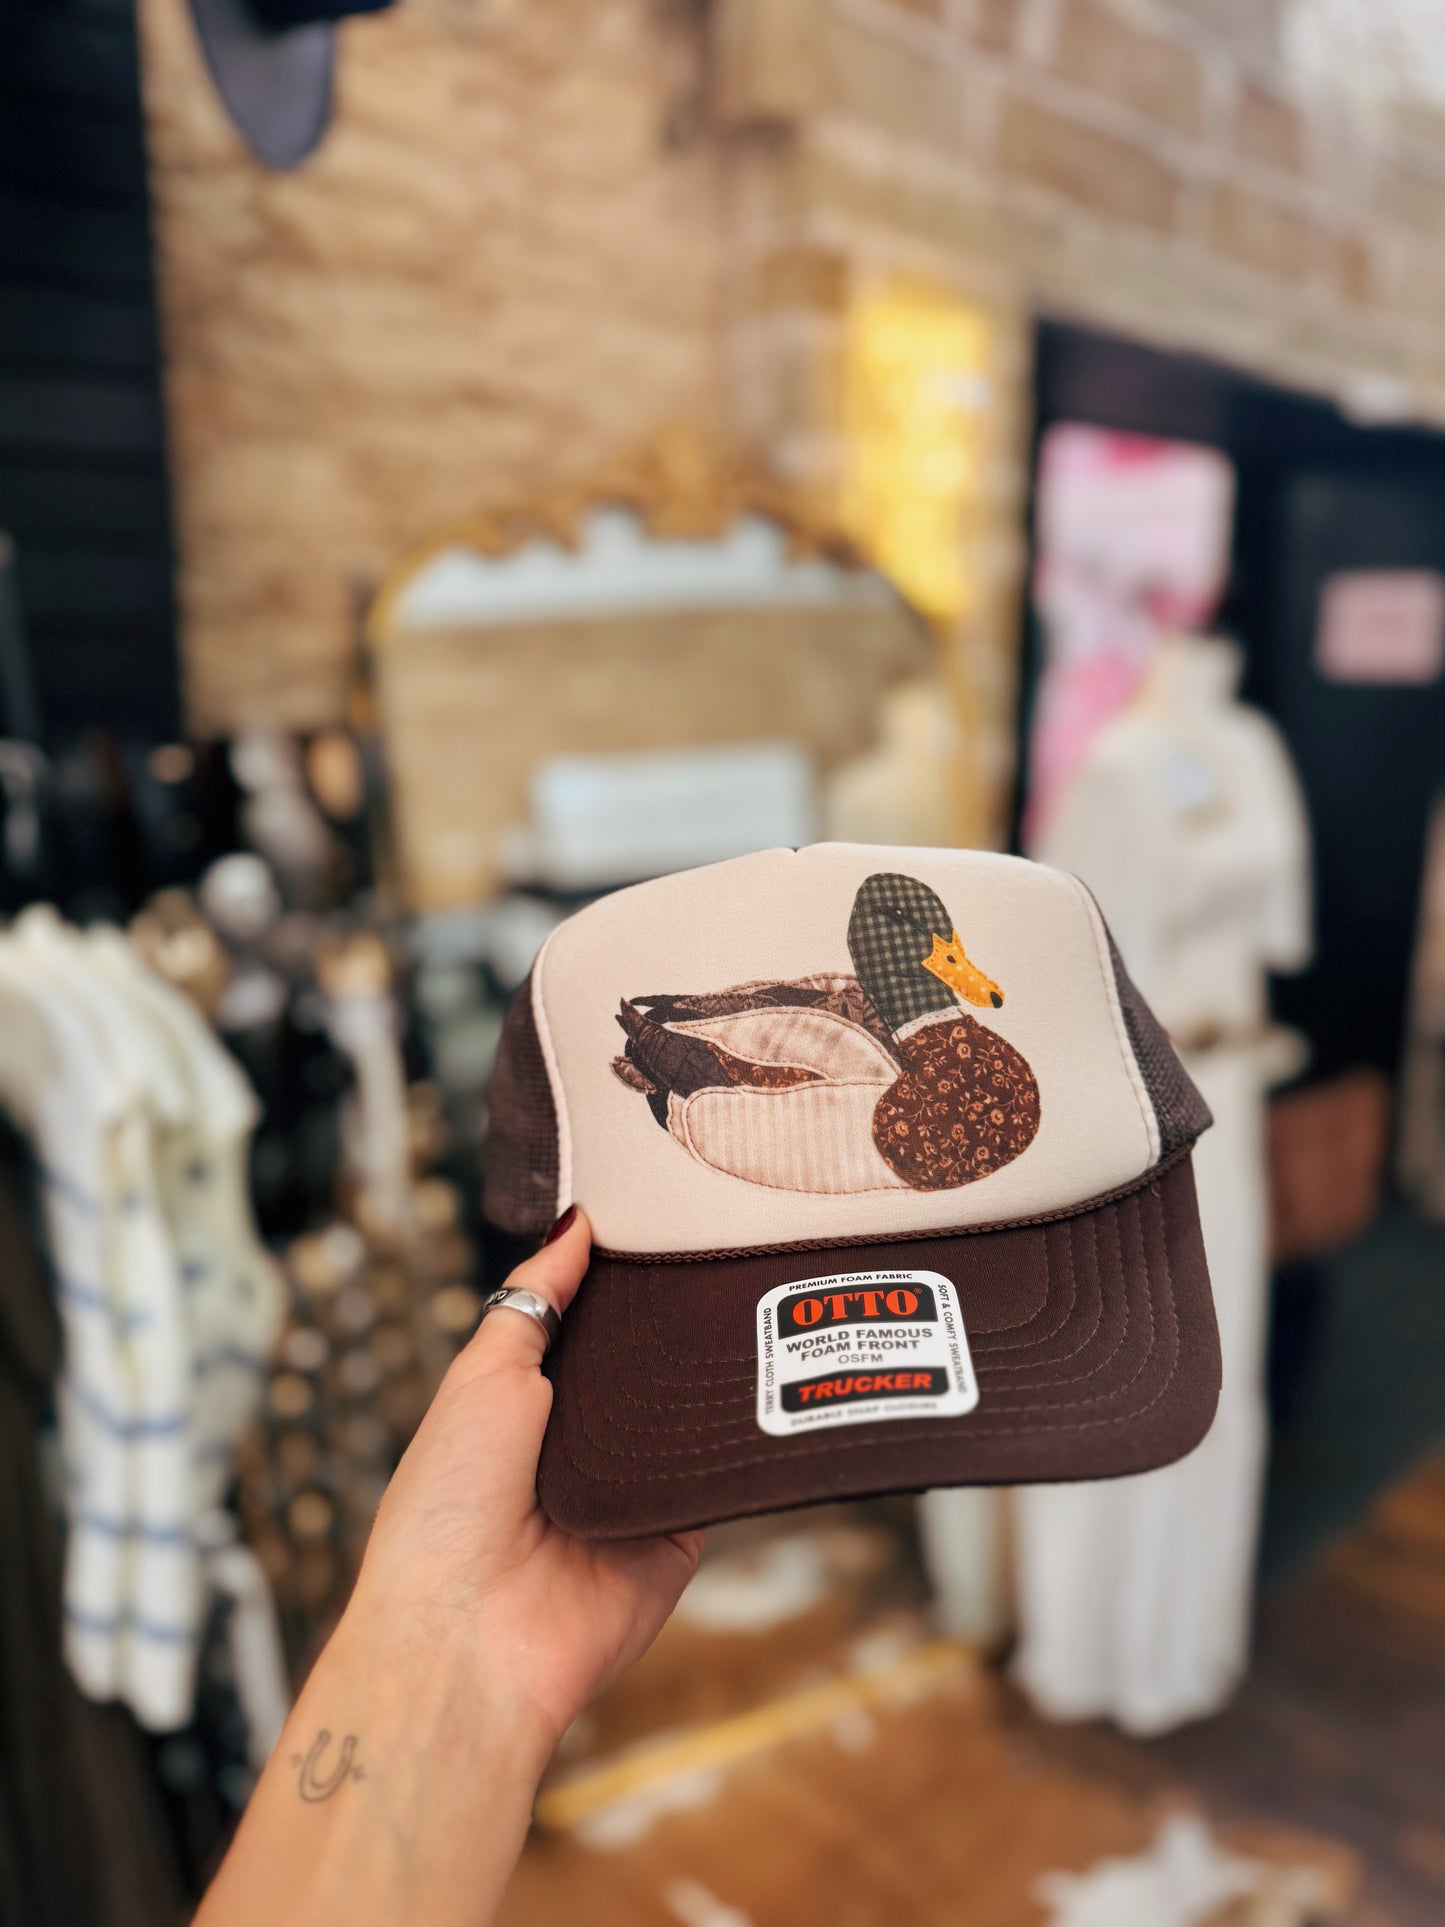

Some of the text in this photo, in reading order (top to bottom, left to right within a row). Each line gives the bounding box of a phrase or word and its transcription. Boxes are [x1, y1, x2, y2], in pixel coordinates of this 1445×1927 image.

[789, 1279, 837, 1291] PREMIUM
[841, 1274, 872, 1282] FOAM
[938, 1284, 950, 1301] SOFT
[793, 1289, 918, 1326] OTTO
[944, 1312, 957, 1340] COMFY
[786, 1328, 933, 1353] WORLD FAMOUS
[801, 1340, 920, 1361] FOAM FRONT
[763, 1307, 774, 1415] TERRY CLOTH SWEATBAND
[838, 1353, 883, 1364] OSFM
[949, 1343, 967, 1393] SWEATBAND
[798, 1372, 933, 1403] TRUCKER
